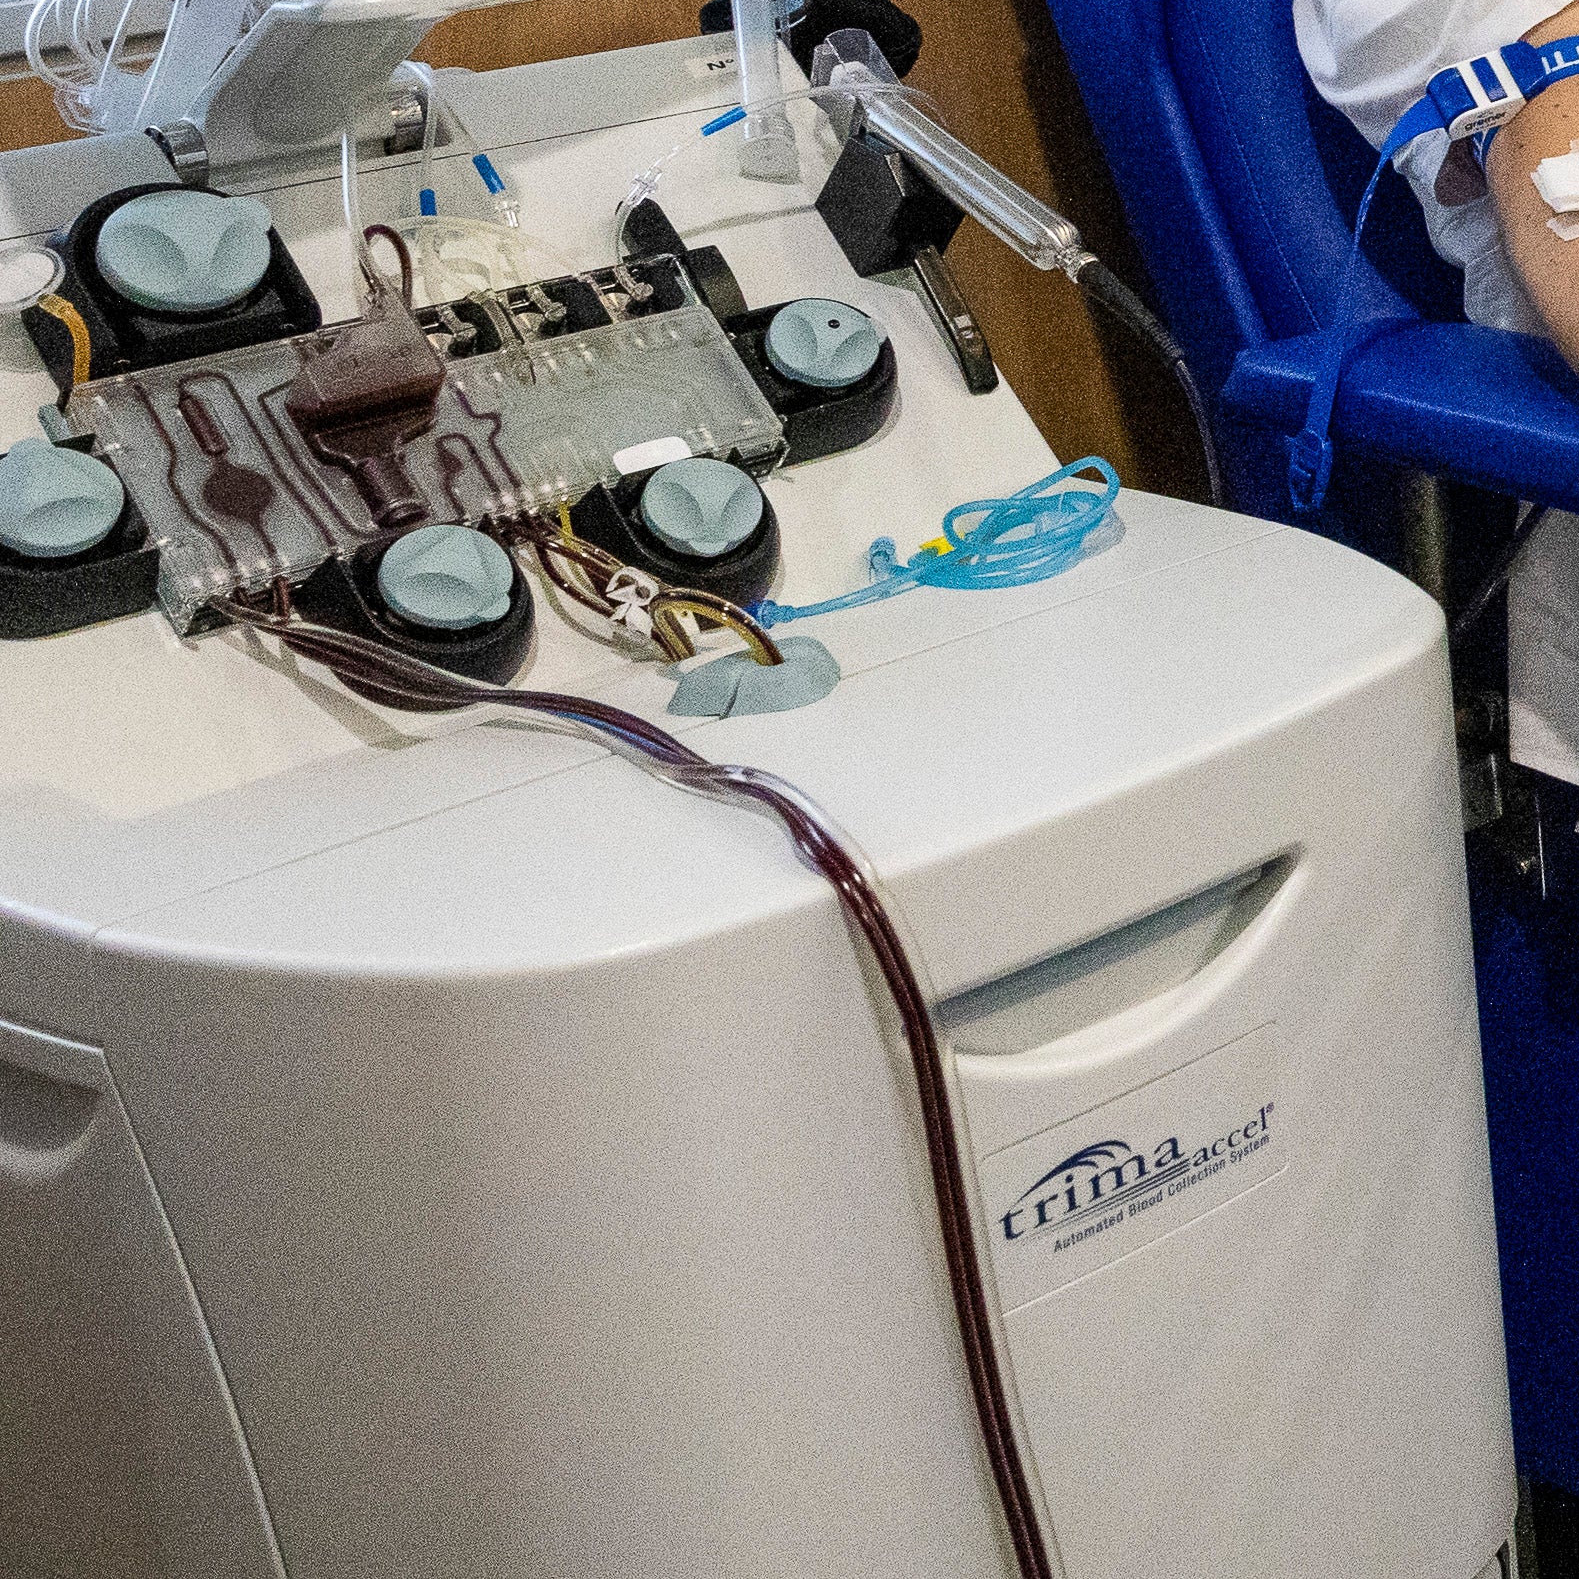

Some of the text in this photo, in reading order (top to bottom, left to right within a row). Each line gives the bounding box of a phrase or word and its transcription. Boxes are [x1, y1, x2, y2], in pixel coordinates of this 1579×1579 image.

[999, 1135, 1187, 1241] trima
[1053, 1133, 1271, 1253] Automated Blood Collection System
